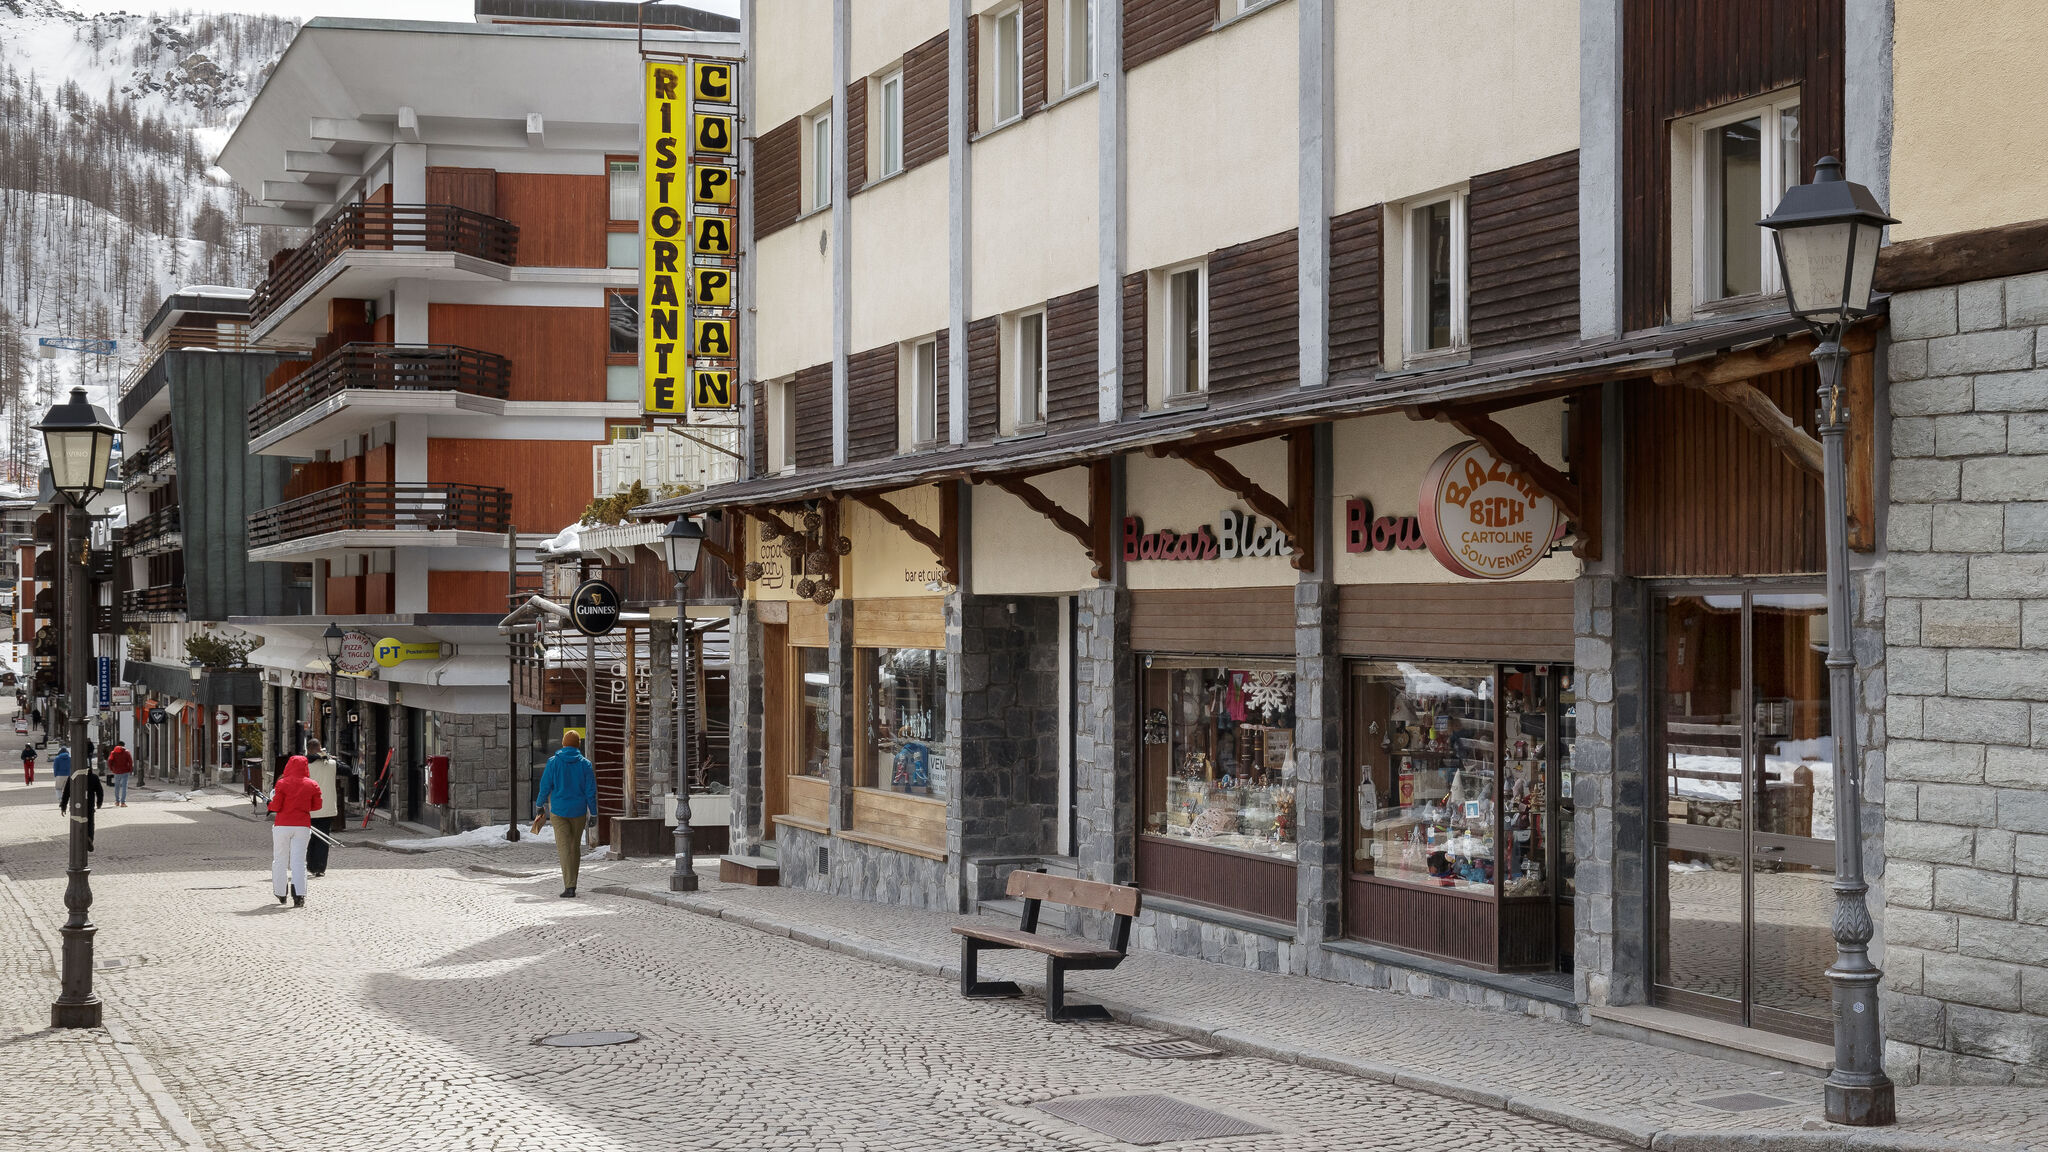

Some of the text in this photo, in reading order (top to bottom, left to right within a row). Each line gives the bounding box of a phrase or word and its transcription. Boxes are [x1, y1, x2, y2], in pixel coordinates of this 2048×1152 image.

[652, 67, 683, 410] RISTORANTE
[698, 65, 729, 405] COPAPAN
[1123, 515, 1218, 562] Bazar
[1461, 531, 1533, 544] CARTOLINE
[1461, 544, 1533, 569] SOUVENIRS
[904, 568, 917, 582] bar
[918, 570, 925, 582] et
[576, 605, 616, 615] GUINNESS
[380, 646, 401, 659] PT
